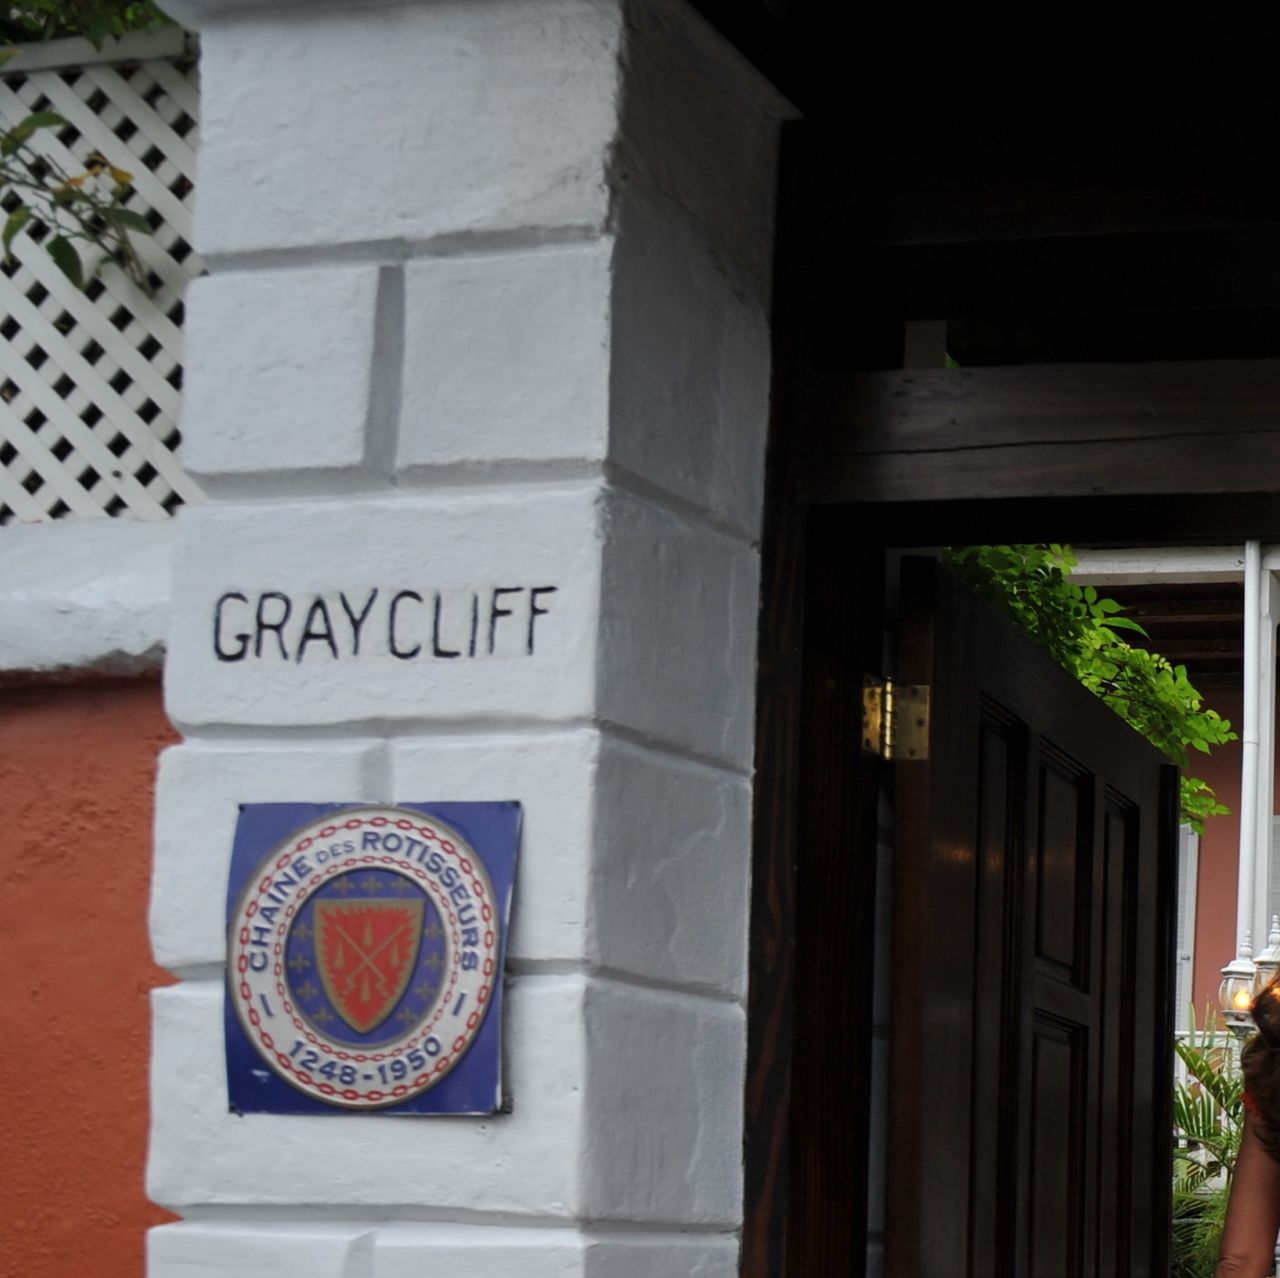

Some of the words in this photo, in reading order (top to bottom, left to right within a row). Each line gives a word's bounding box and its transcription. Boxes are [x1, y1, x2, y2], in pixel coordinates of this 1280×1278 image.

[214, 587, 558, 664] GRAYCLIFF
[251, 856, 312, 973] CHAINE
[315, 840, 355, 865] DES
[361, 831, 480, 972] ROTISSEURS
